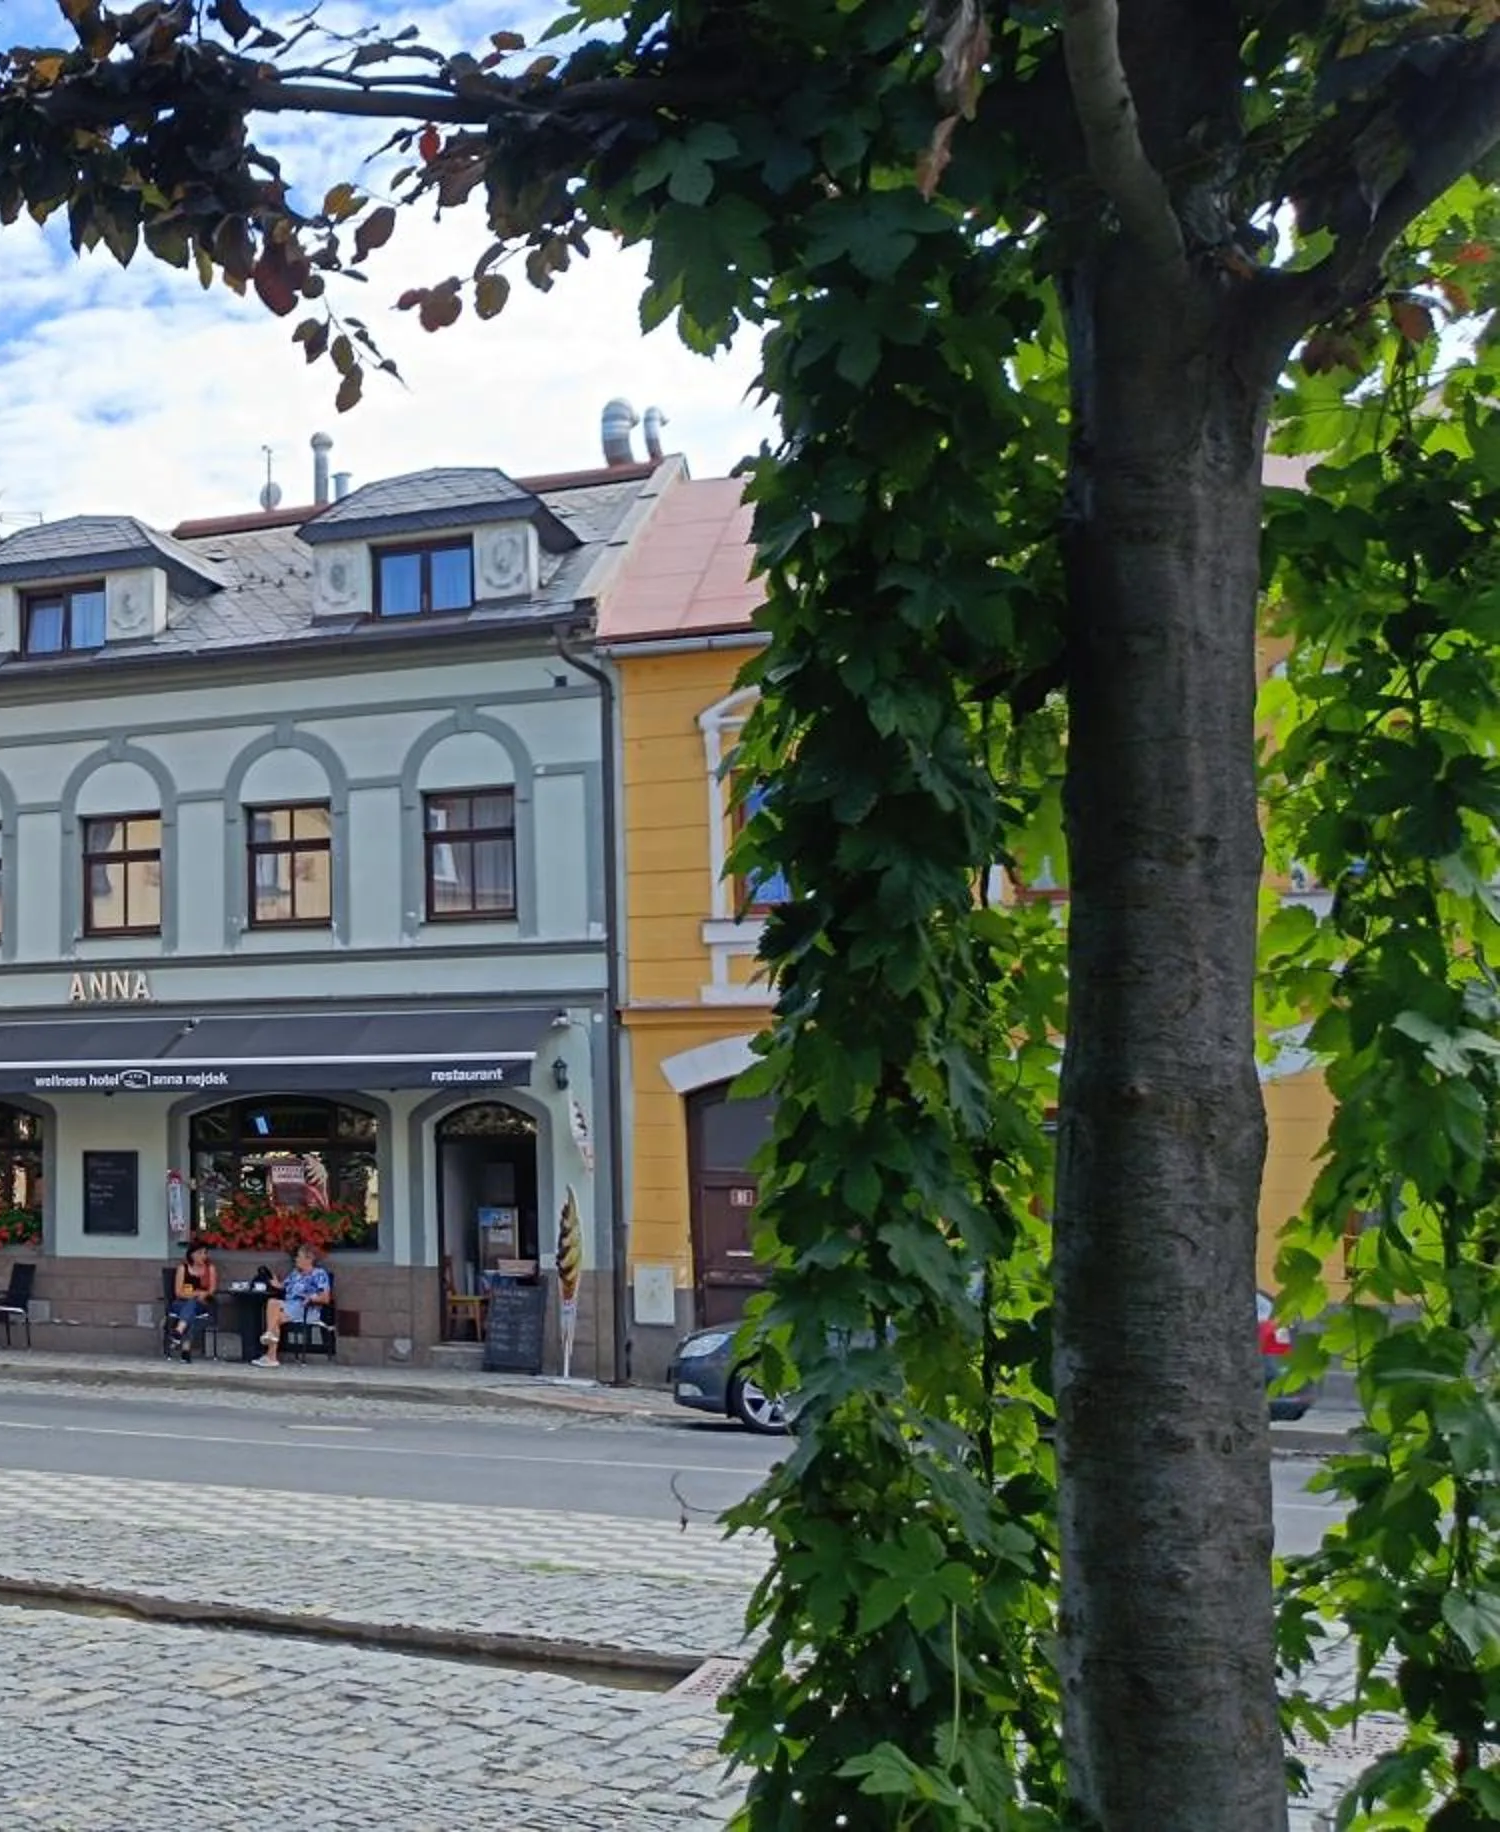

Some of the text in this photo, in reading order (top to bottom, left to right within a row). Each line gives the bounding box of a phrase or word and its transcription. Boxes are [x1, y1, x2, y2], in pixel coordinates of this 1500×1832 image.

[69, 969, 151, 1001] ANNA
[35, 1072, 229, 1087] wellness hotel anna nejdek
[431, 1067, 504, 1081] restaurant
